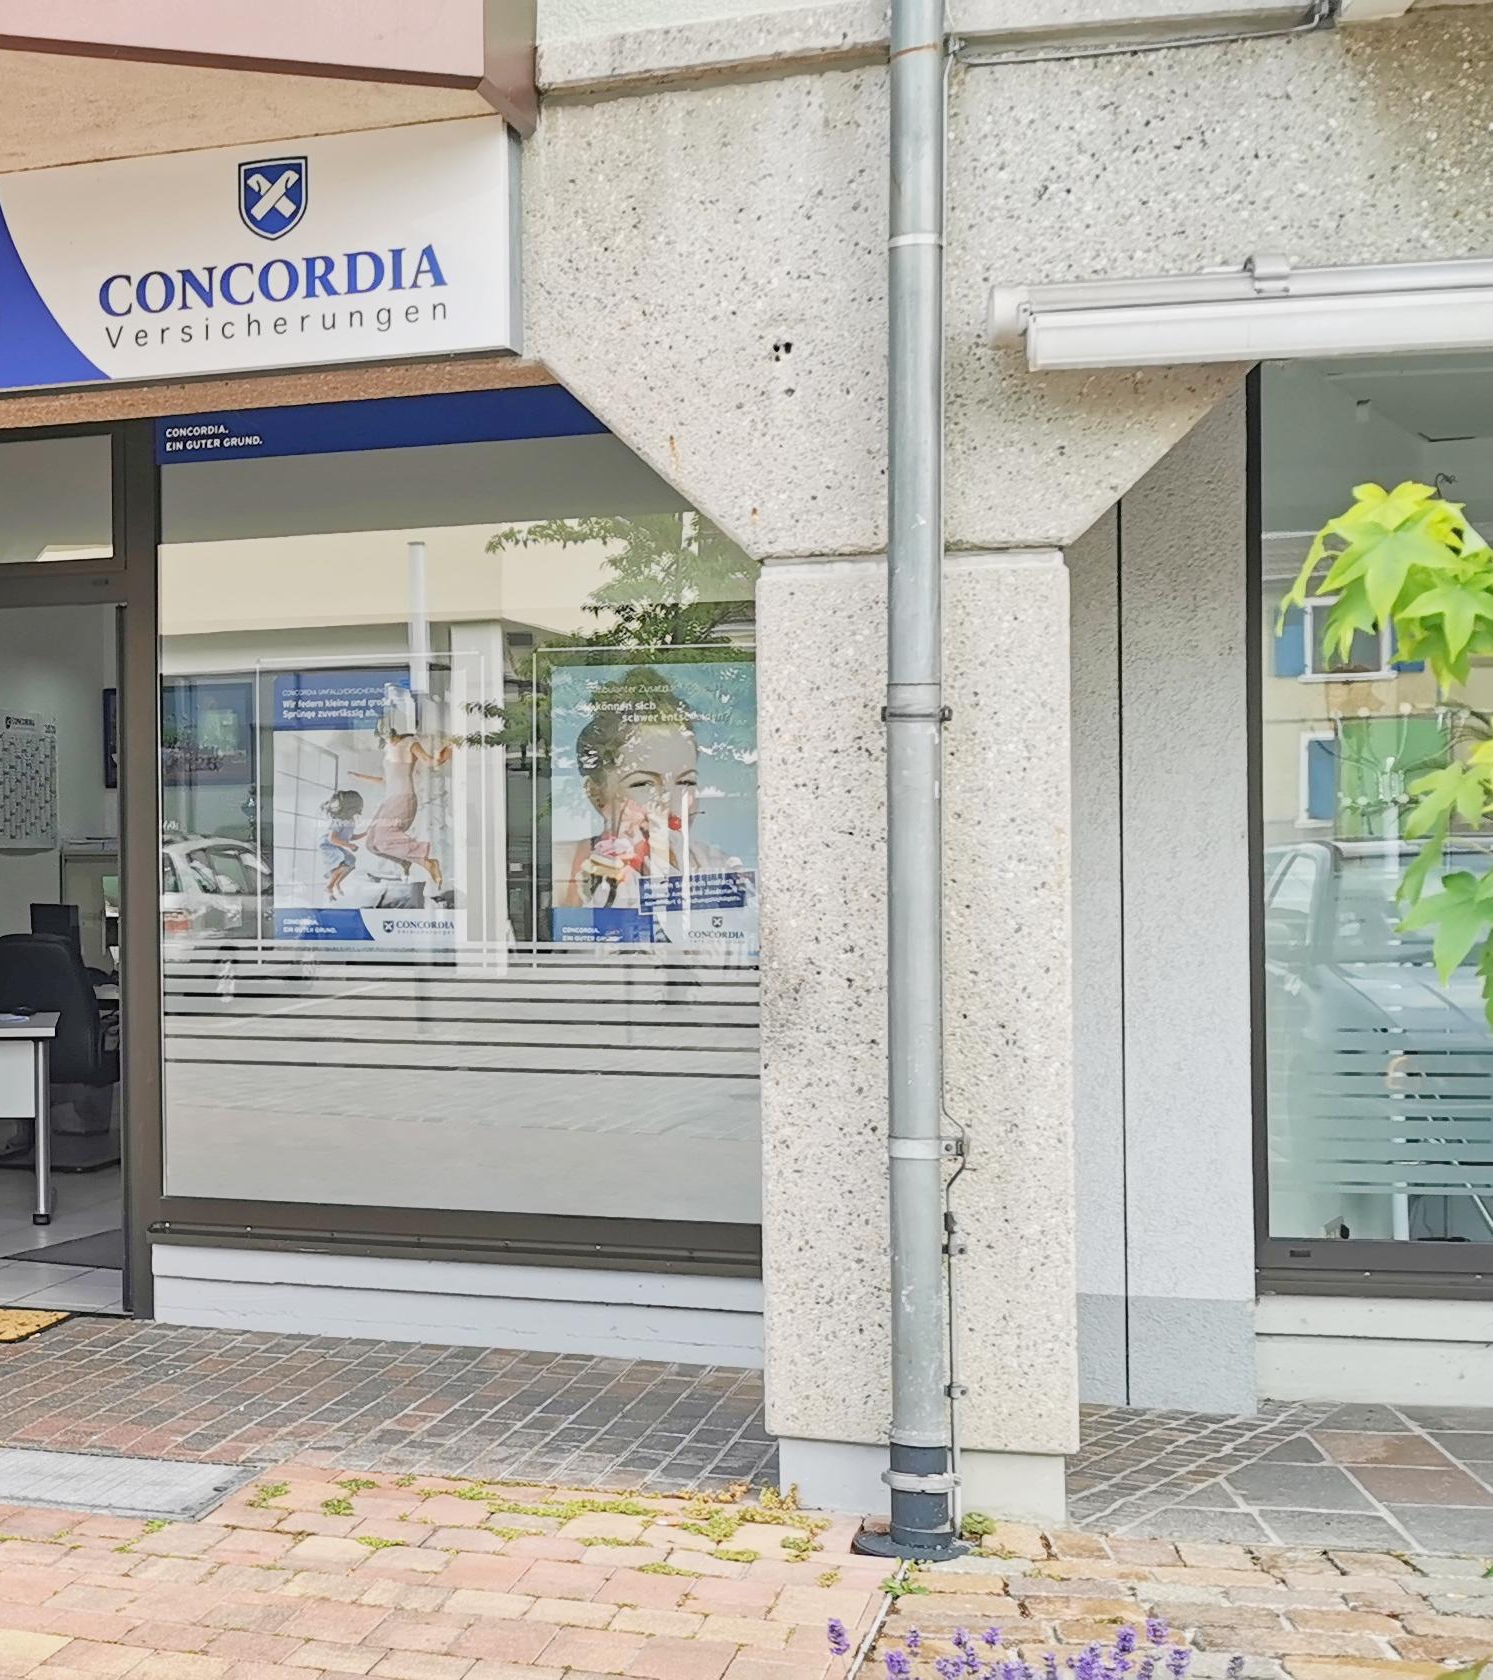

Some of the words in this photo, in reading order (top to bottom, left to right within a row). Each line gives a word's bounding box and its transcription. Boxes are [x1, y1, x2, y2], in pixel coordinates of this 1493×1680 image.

[98, 244, 448, 317] CONCORDIA
[105, 300, 447, 349] Versicherungen
[165, 425, 229, 437] CONCORDIA.
[166, 442, 183, 451] EIN
[186, 439, 221, 450] GUTER
[223, 436, 263, 447] GRUND.
[282, 700, 296, 708] Wir
[351, 699, 367, 707] und
[635, 700, 657, 711] sich
[282, 710, 316, 719] Sprünge
[622, 713, 658, 723] schwer
[396, 919, 455, 929] CONCORDIA
[687, 930, 745, 939] CONCORDIA
